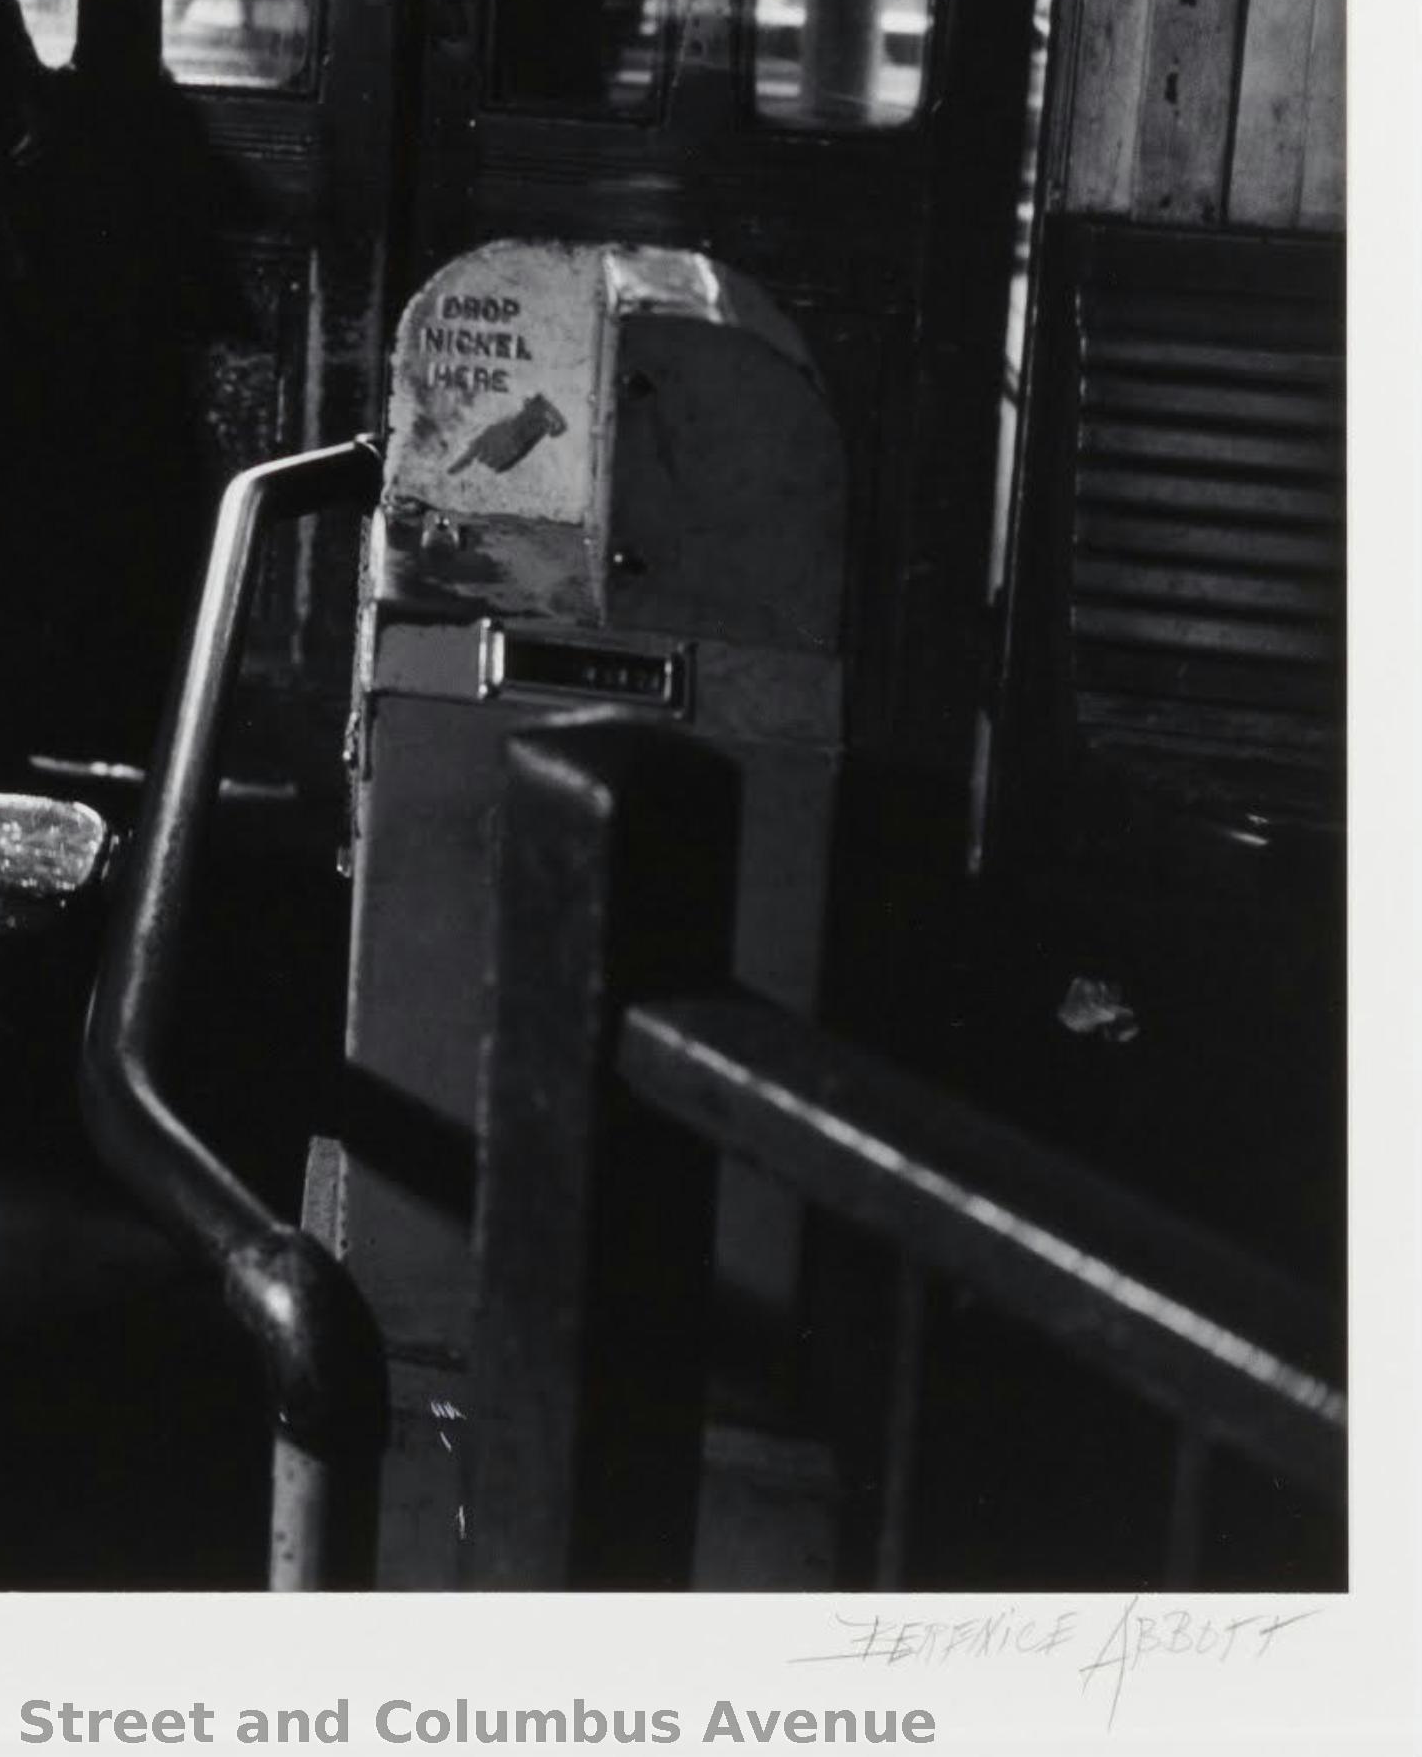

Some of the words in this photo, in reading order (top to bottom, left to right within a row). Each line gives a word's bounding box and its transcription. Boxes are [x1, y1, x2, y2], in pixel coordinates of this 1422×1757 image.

[442, 295, 521, 323] DROP
[424, 327, 533, 361] NICKEL
[432, 364, 510, 393] HERE
[1078, 1594, 1323, 1733] ABBOTT
